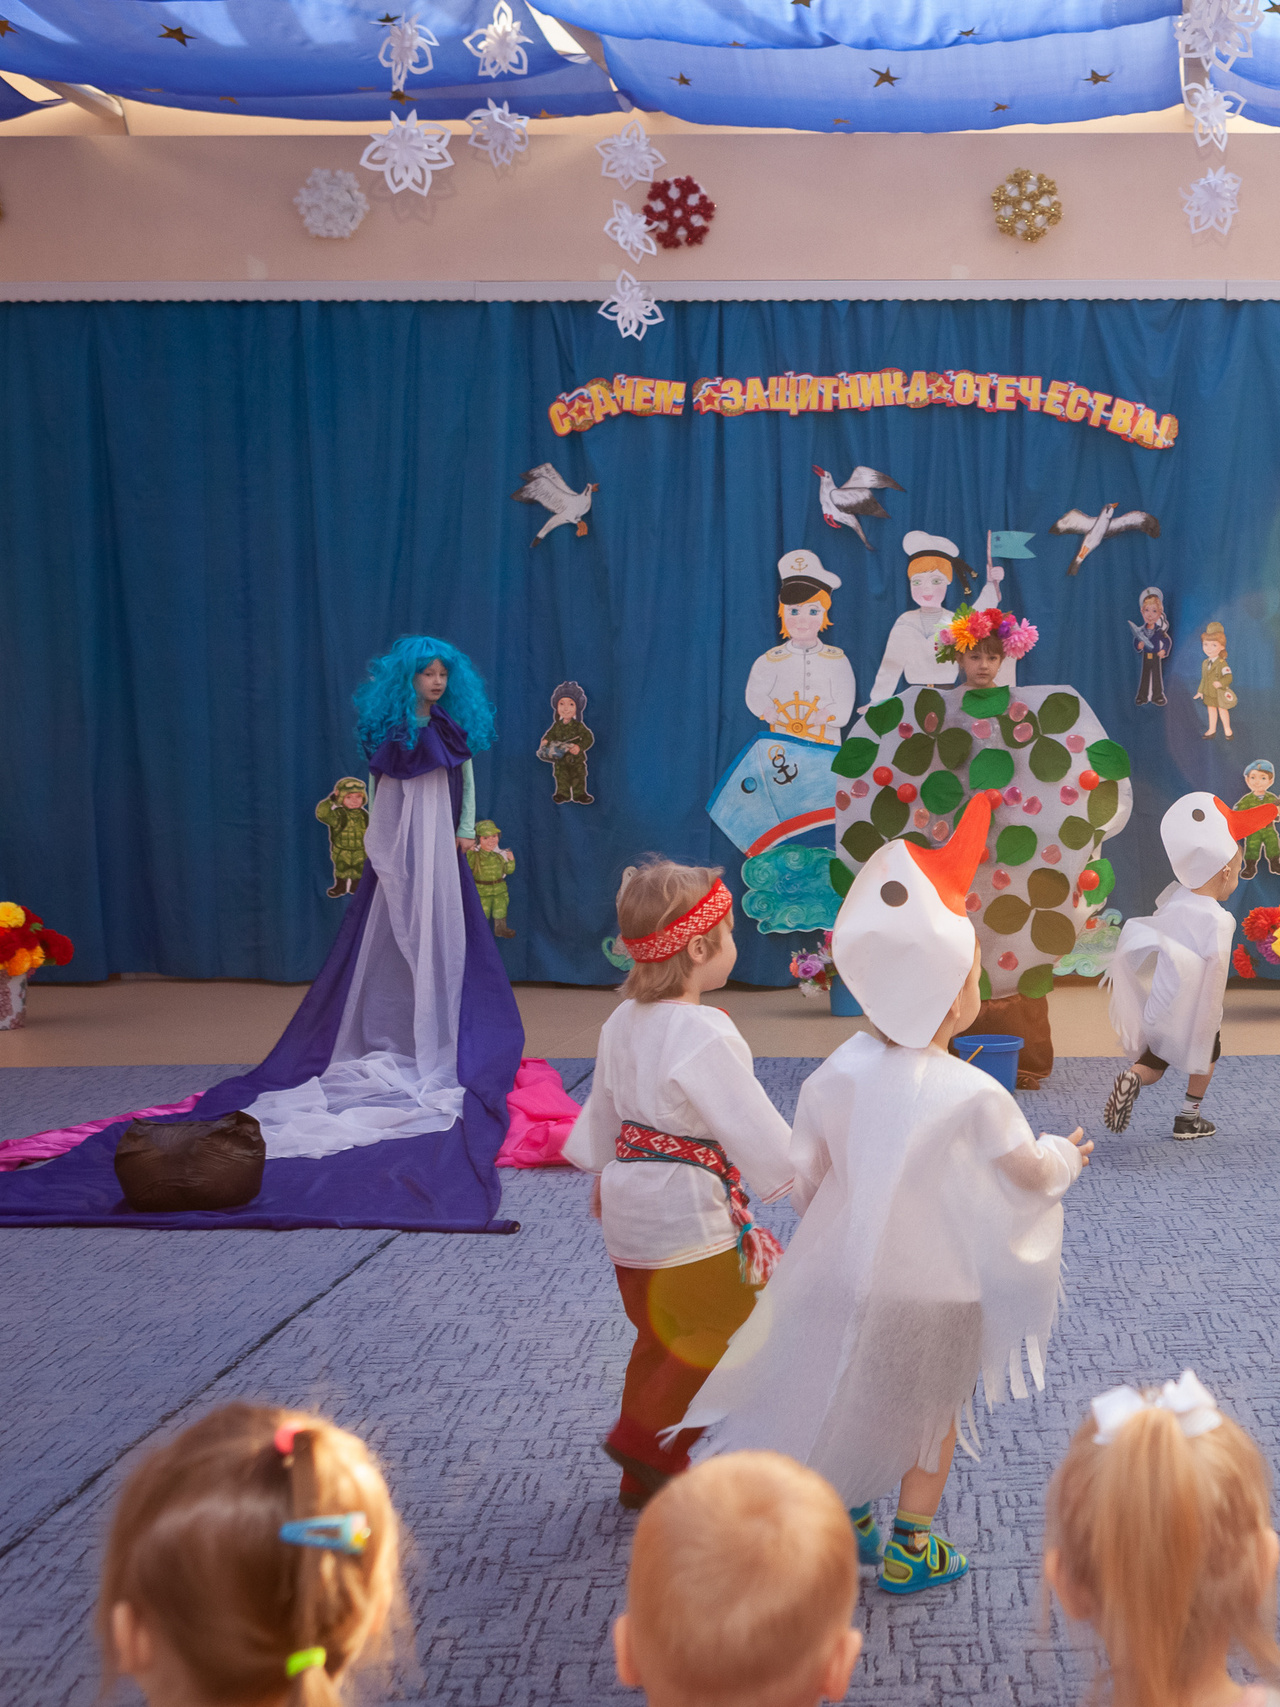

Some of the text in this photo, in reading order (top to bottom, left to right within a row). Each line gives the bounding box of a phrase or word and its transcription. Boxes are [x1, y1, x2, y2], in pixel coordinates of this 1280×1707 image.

[548, 371, 1173, 450] С ДНЕМ ЗАЩИТНИКА ОТЕЧЕСТВА!
